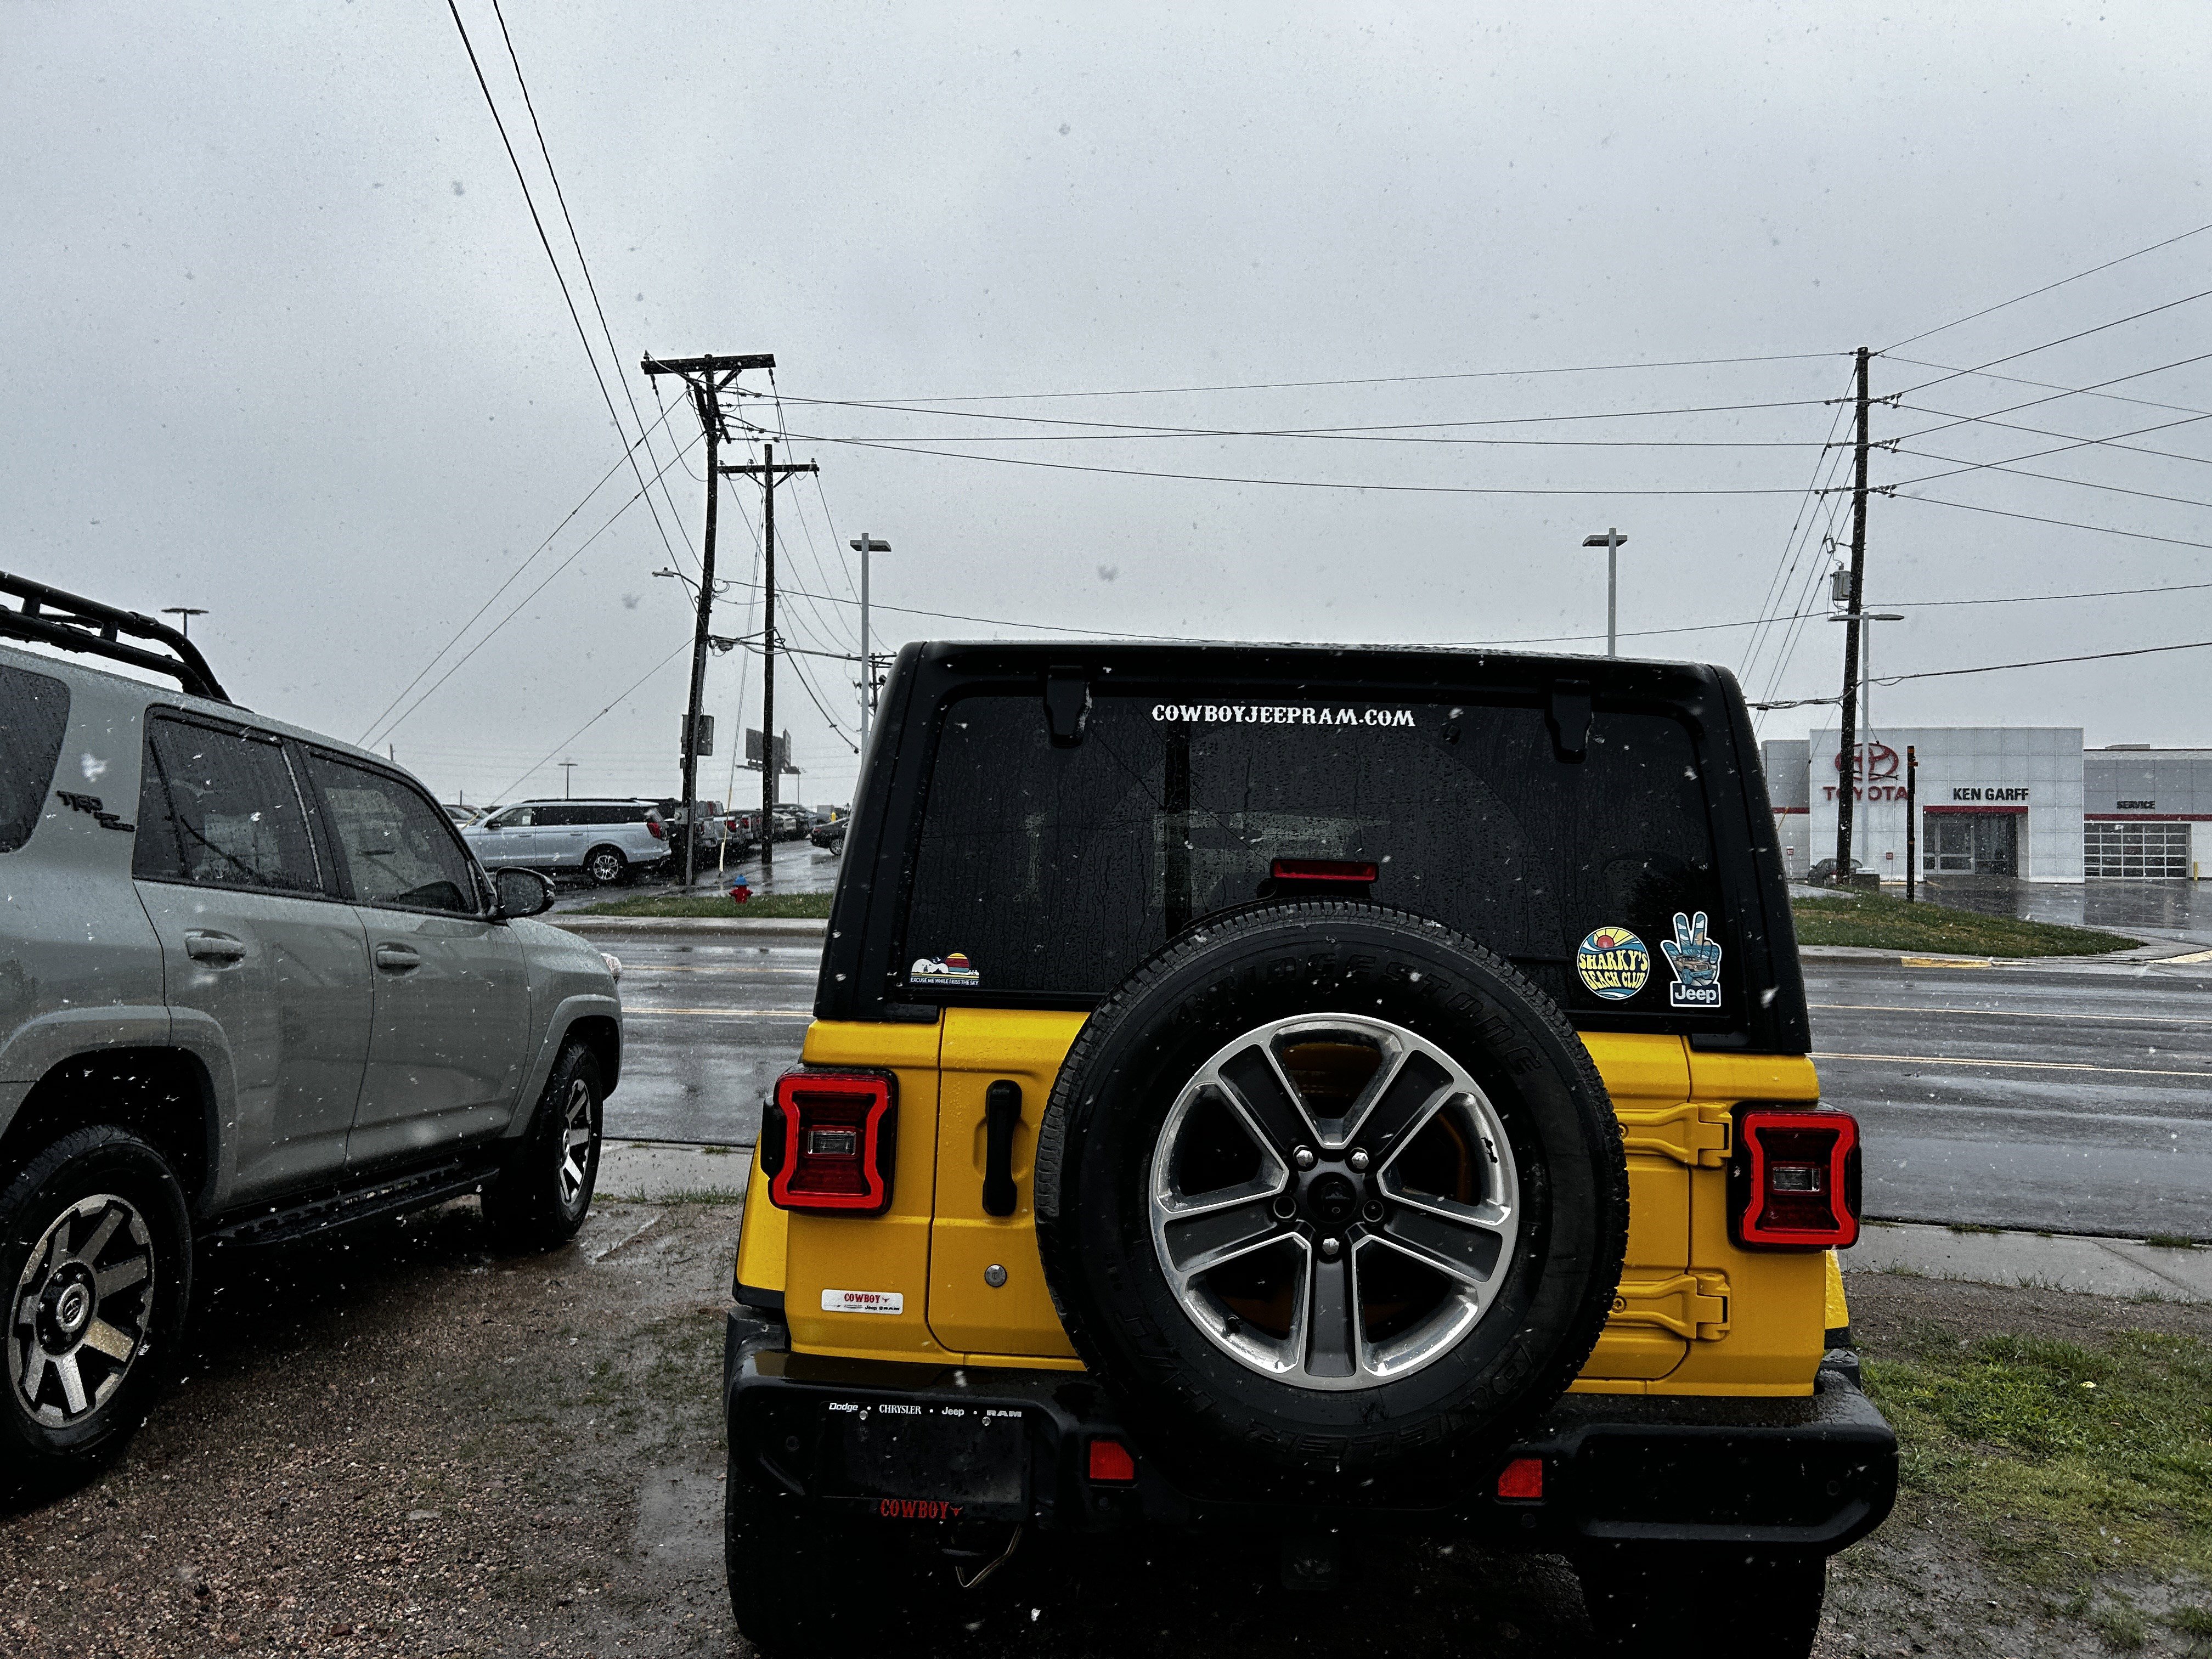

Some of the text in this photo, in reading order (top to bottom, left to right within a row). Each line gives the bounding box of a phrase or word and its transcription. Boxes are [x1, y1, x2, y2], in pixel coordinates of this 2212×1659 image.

[1152, 704, 1415, 727] COWBOYJEEPRAM.COM
[1823, 786, 1908, 801] TYOTA
[1953, 788, 2029, 800] KEN GARFF
[2117, 800, 2155, 809] SERVICE
[1579, 950, 1648, 971] SHARKY'S
[1581, 970, 1645, 990] BEACH CLUB
[1674, 985, 1717, 1003] Jeep
[844, 1293, 881, 1304] COWBOY
[829, 1402, 858, 1413] Dodge
[879, 1404, 922, 1414] CHRYSLER
[941, 1407, 964, 1417] Jeep
[881, 1499, 950, 1519] COWBOY
